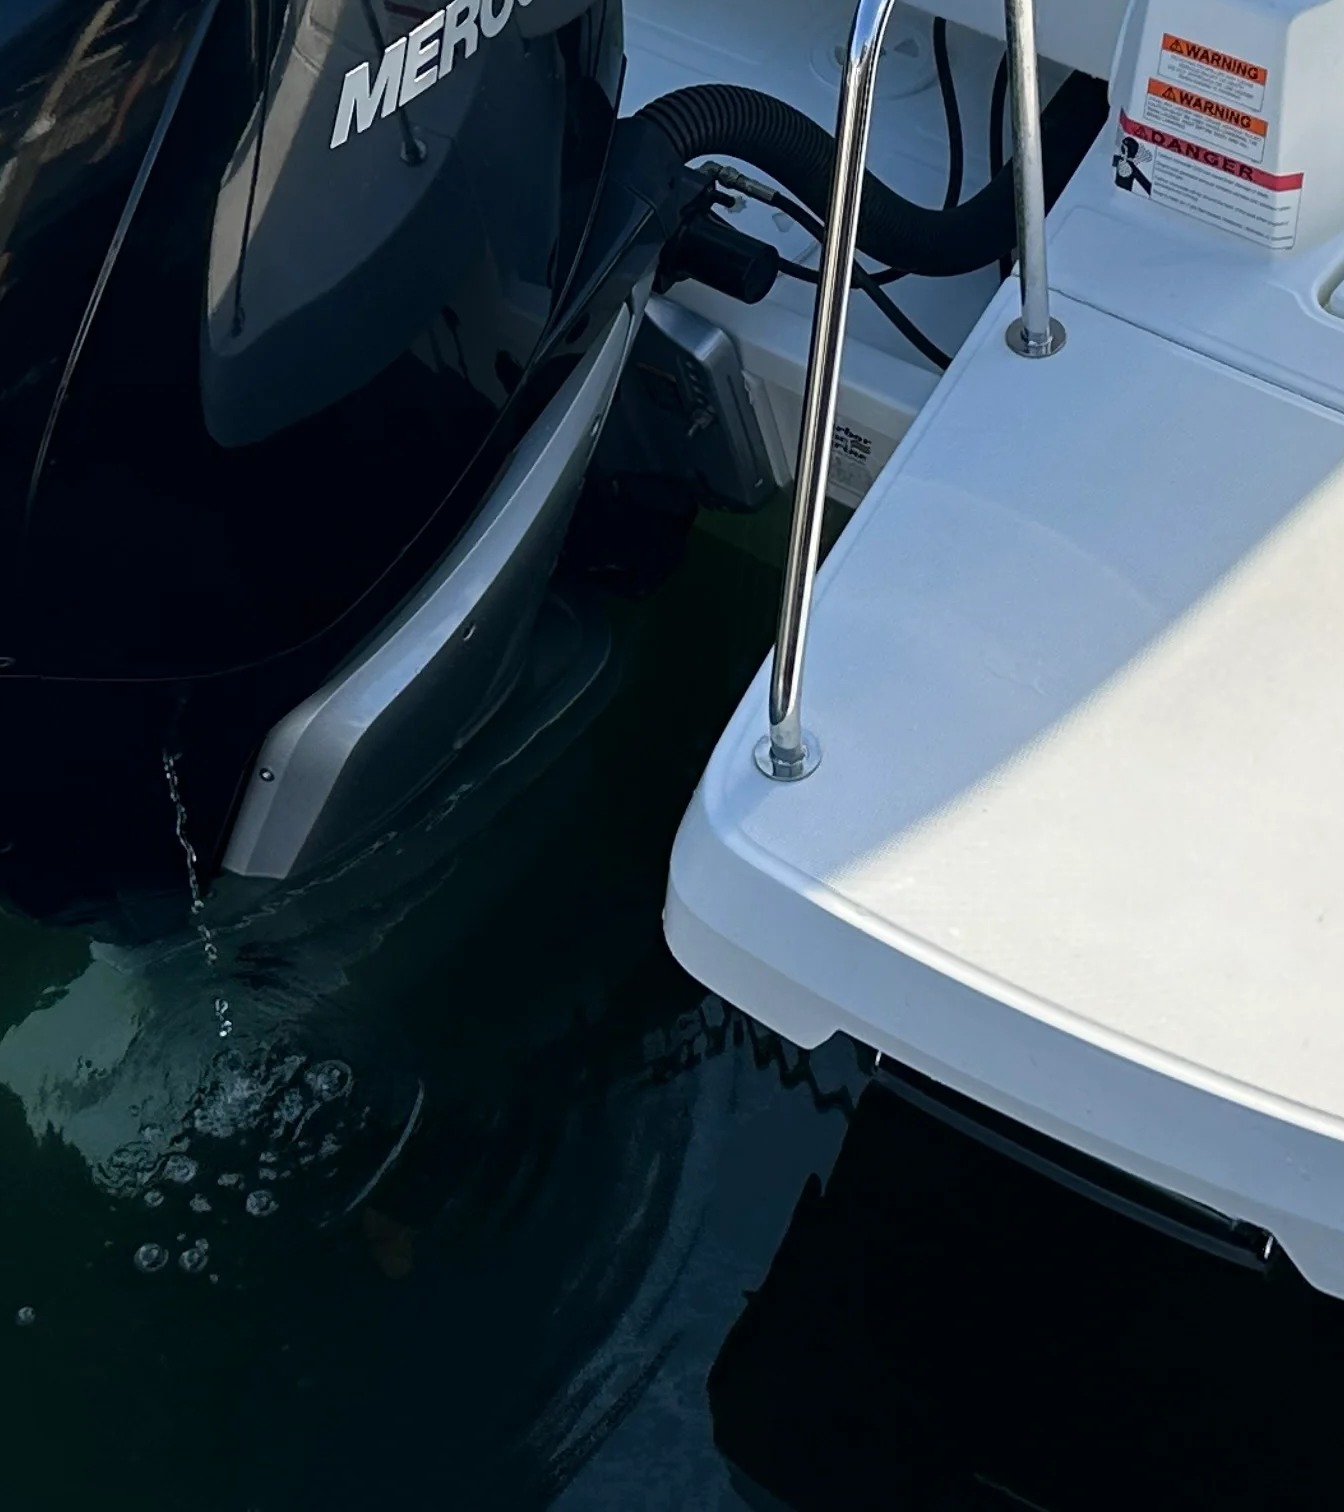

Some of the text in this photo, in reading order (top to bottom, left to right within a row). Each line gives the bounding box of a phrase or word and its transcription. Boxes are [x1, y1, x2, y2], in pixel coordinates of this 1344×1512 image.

[1185, 42, 1259, 80] WARNING
[1178, 91, 1252, 129] WARNING
[1150, 130, 1255, 182] DANGER
